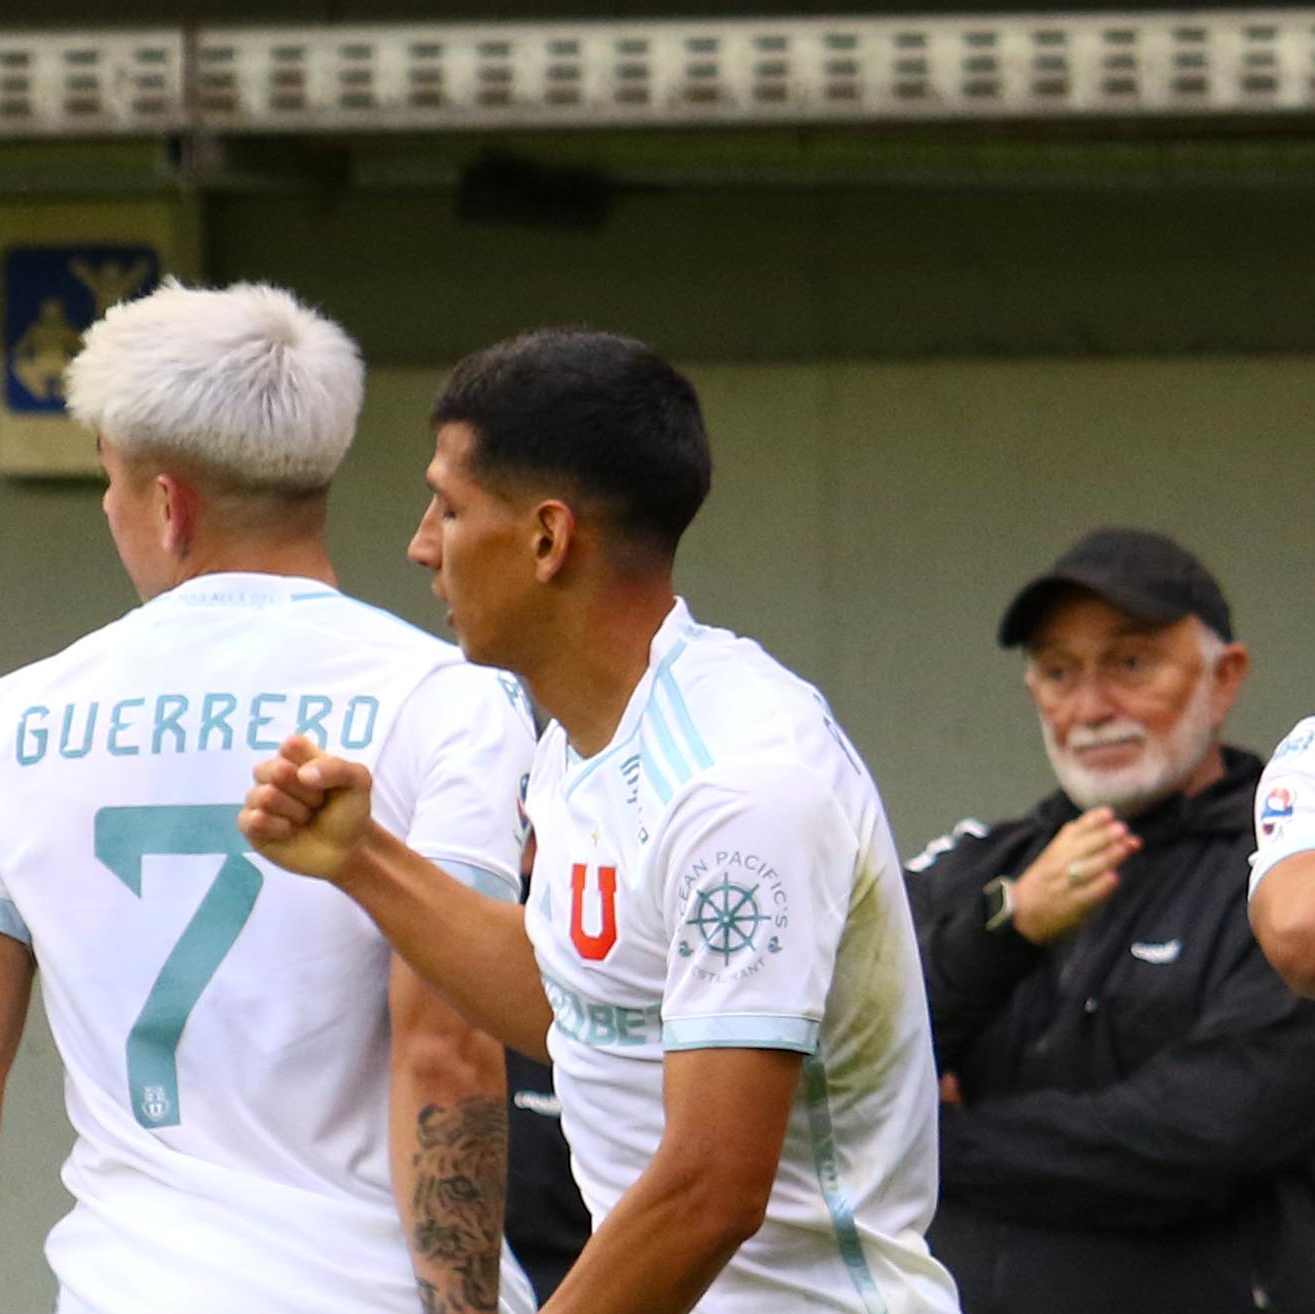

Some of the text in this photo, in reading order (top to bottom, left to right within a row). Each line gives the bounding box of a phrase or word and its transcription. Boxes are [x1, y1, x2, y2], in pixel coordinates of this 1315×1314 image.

[15, 692, 380, 767] GUERRERO
[570, 864, 617, 961] U
[94, 803, 264, 1128] 7
